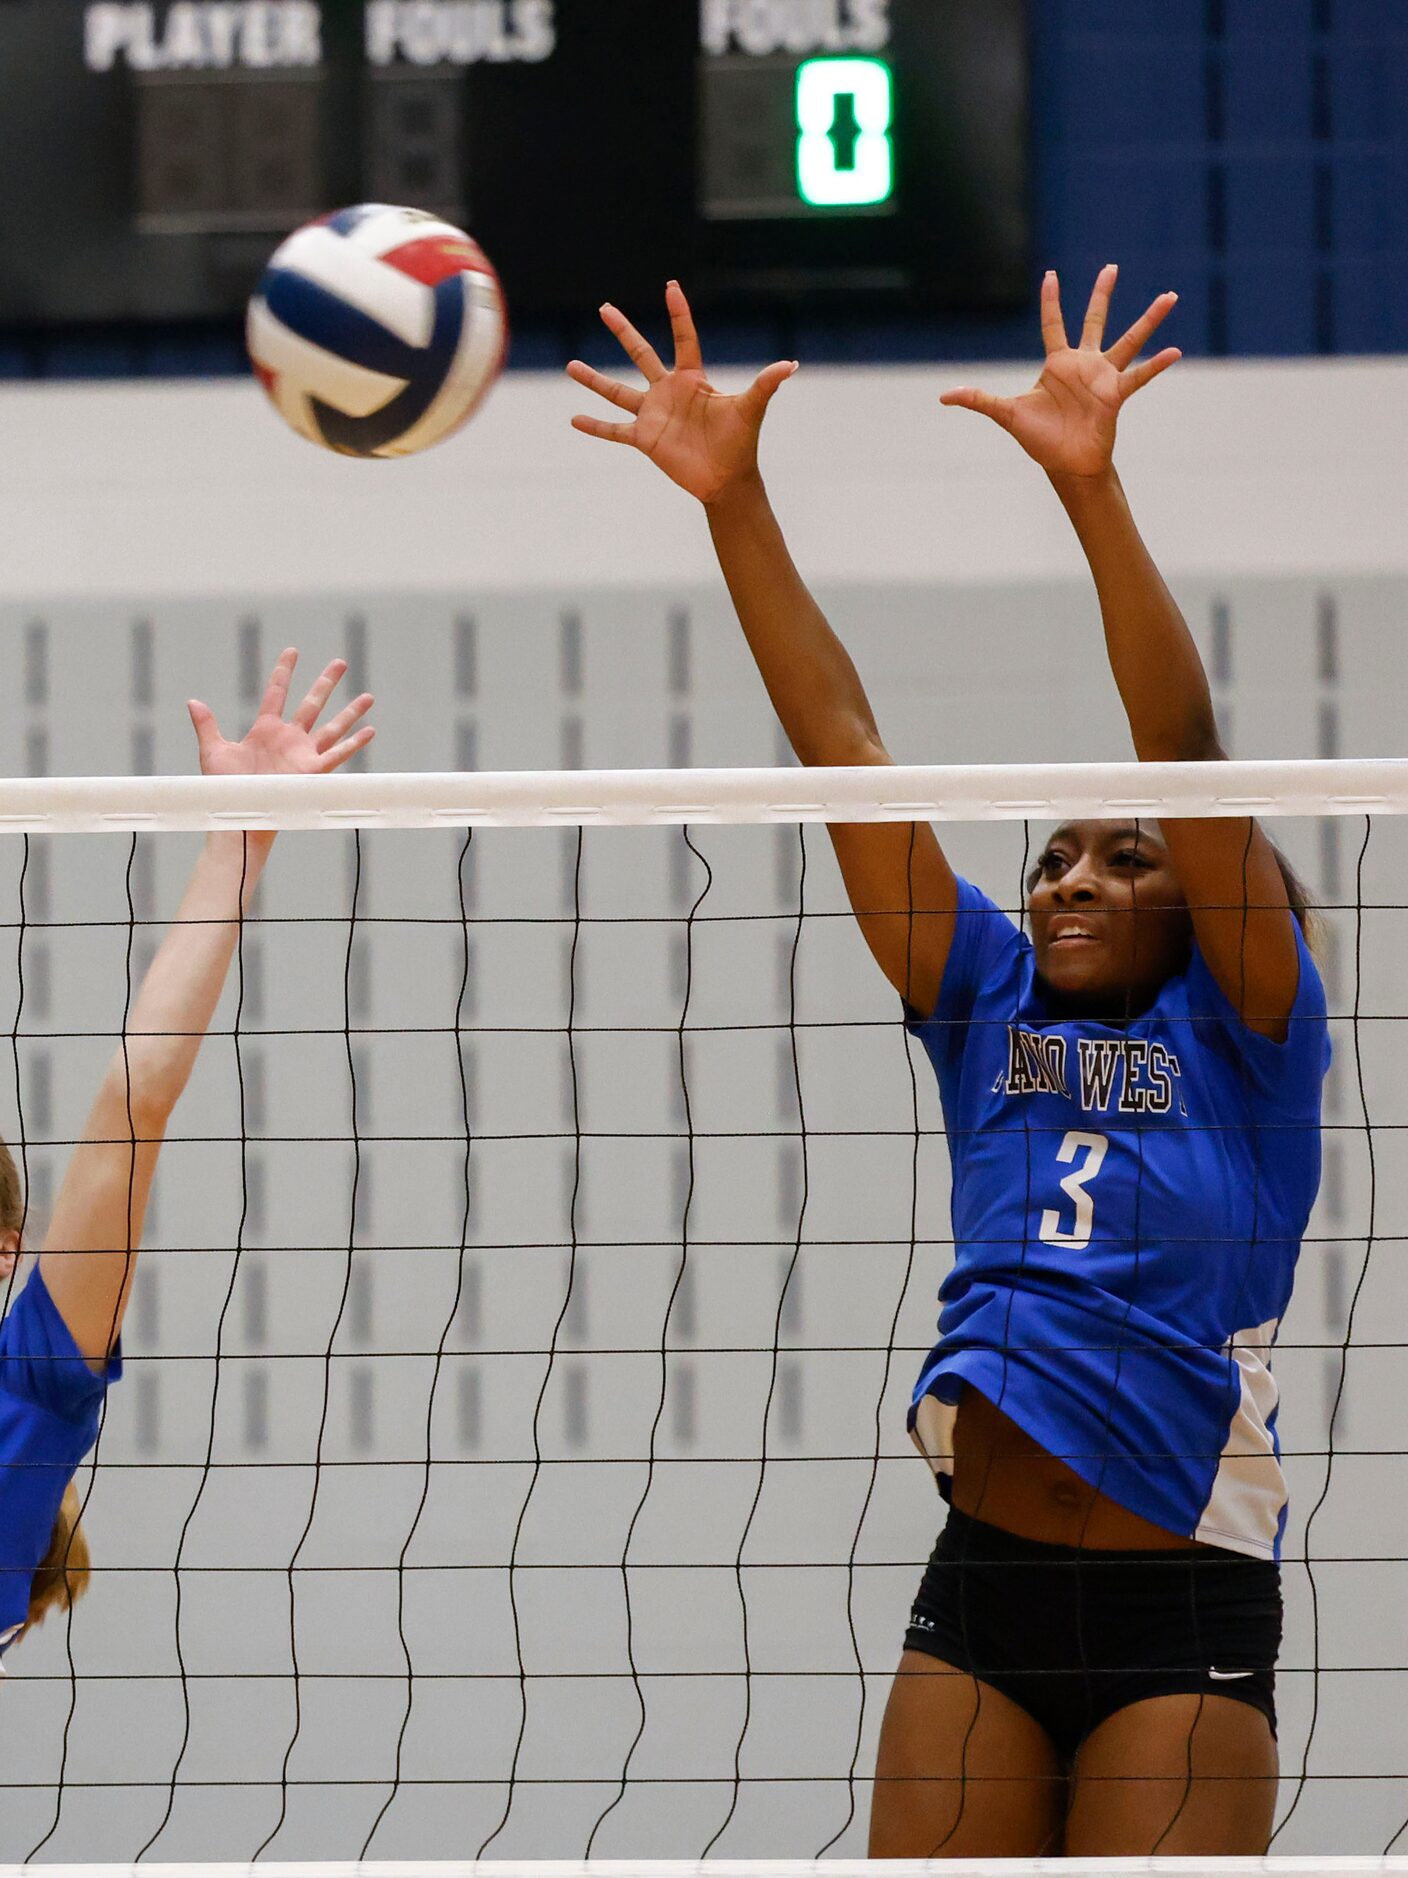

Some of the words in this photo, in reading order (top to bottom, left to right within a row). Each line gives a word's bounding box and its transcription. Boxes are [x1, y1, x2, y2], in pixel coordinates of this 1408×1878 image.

[85, 0, 321, 71] PLAYER
[365, 0, 555, 63] FOULS
[700, 0, 890, 55] FOULS
[796, 56, 891, 206] 0
[1039, 1131, 1109, 1250] 3
